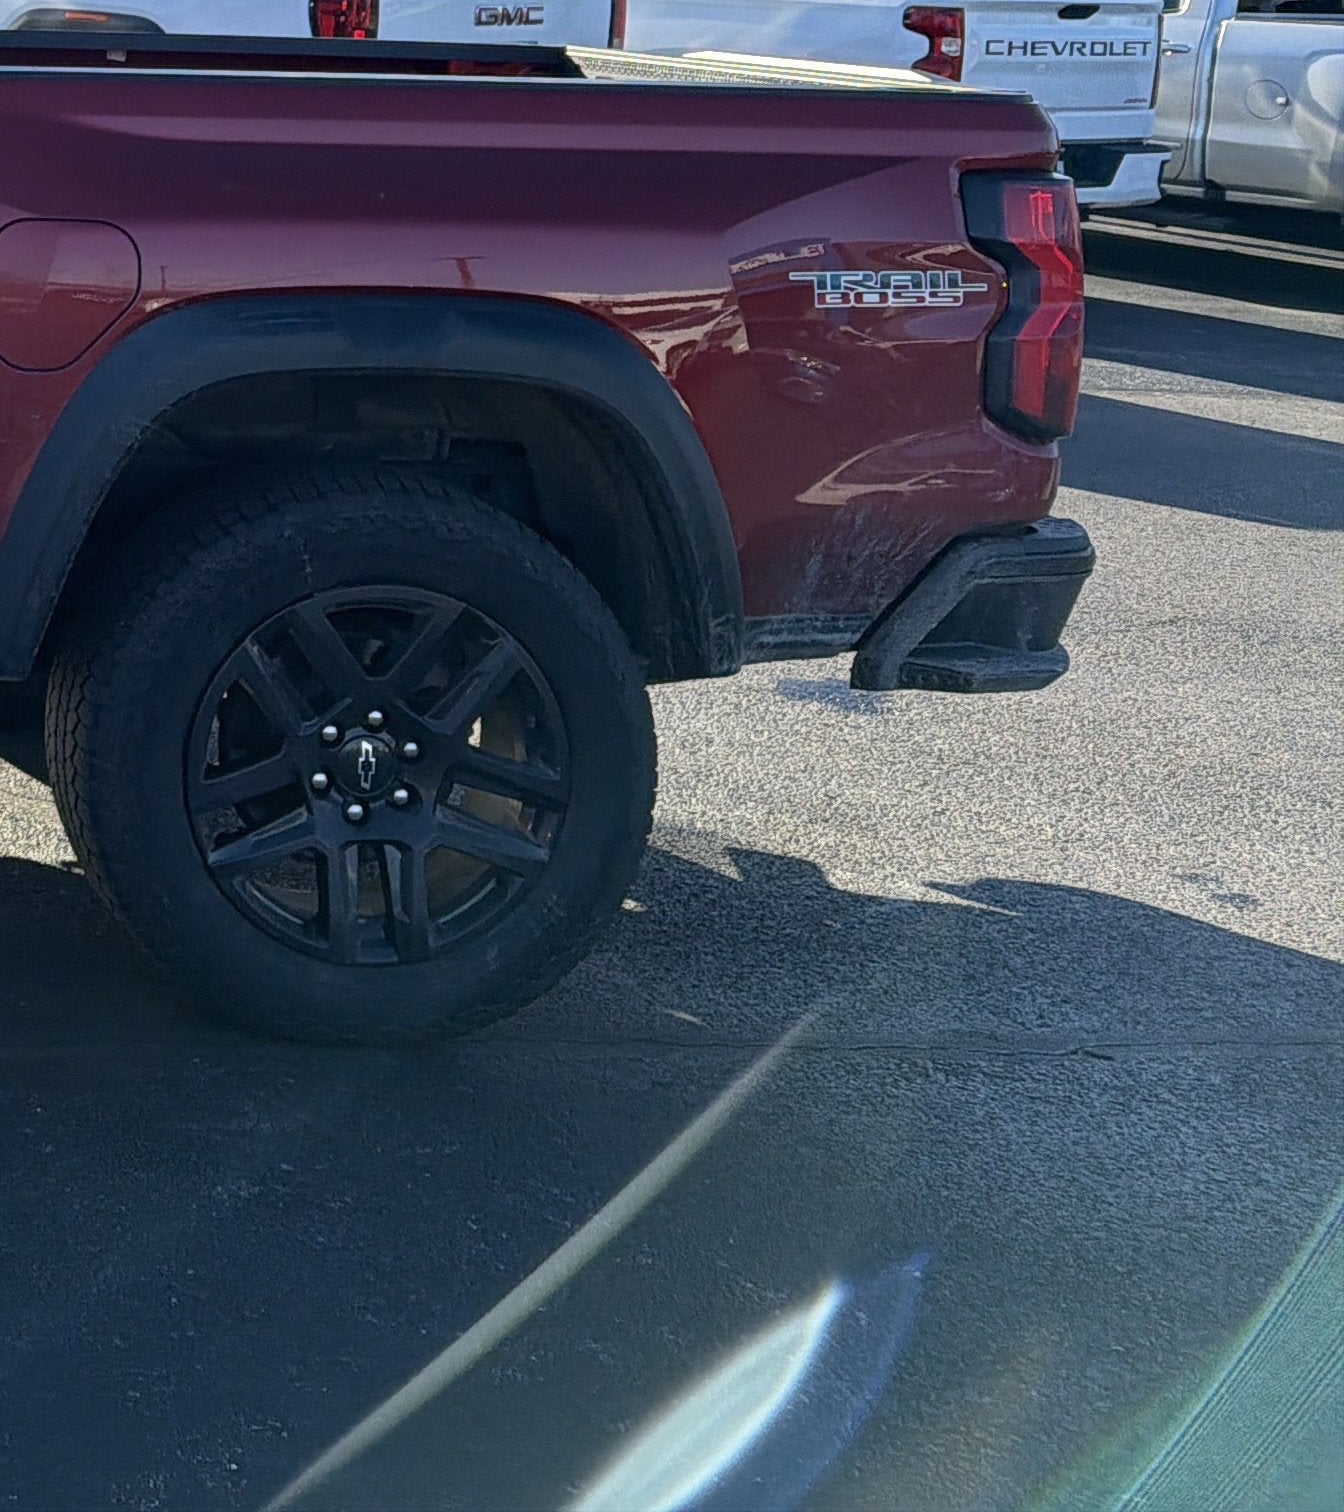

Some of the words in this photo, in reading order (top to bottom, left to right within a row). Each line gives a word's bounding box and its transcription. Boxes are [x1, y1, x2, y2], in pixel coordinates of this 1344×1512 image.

[474, 5, 544, 26] GMC
[985, 39, 1152, 57] CHEVROLET
[788, 270, 988, 292] TRAIL
[814, 289, 964, 308] BOSS
